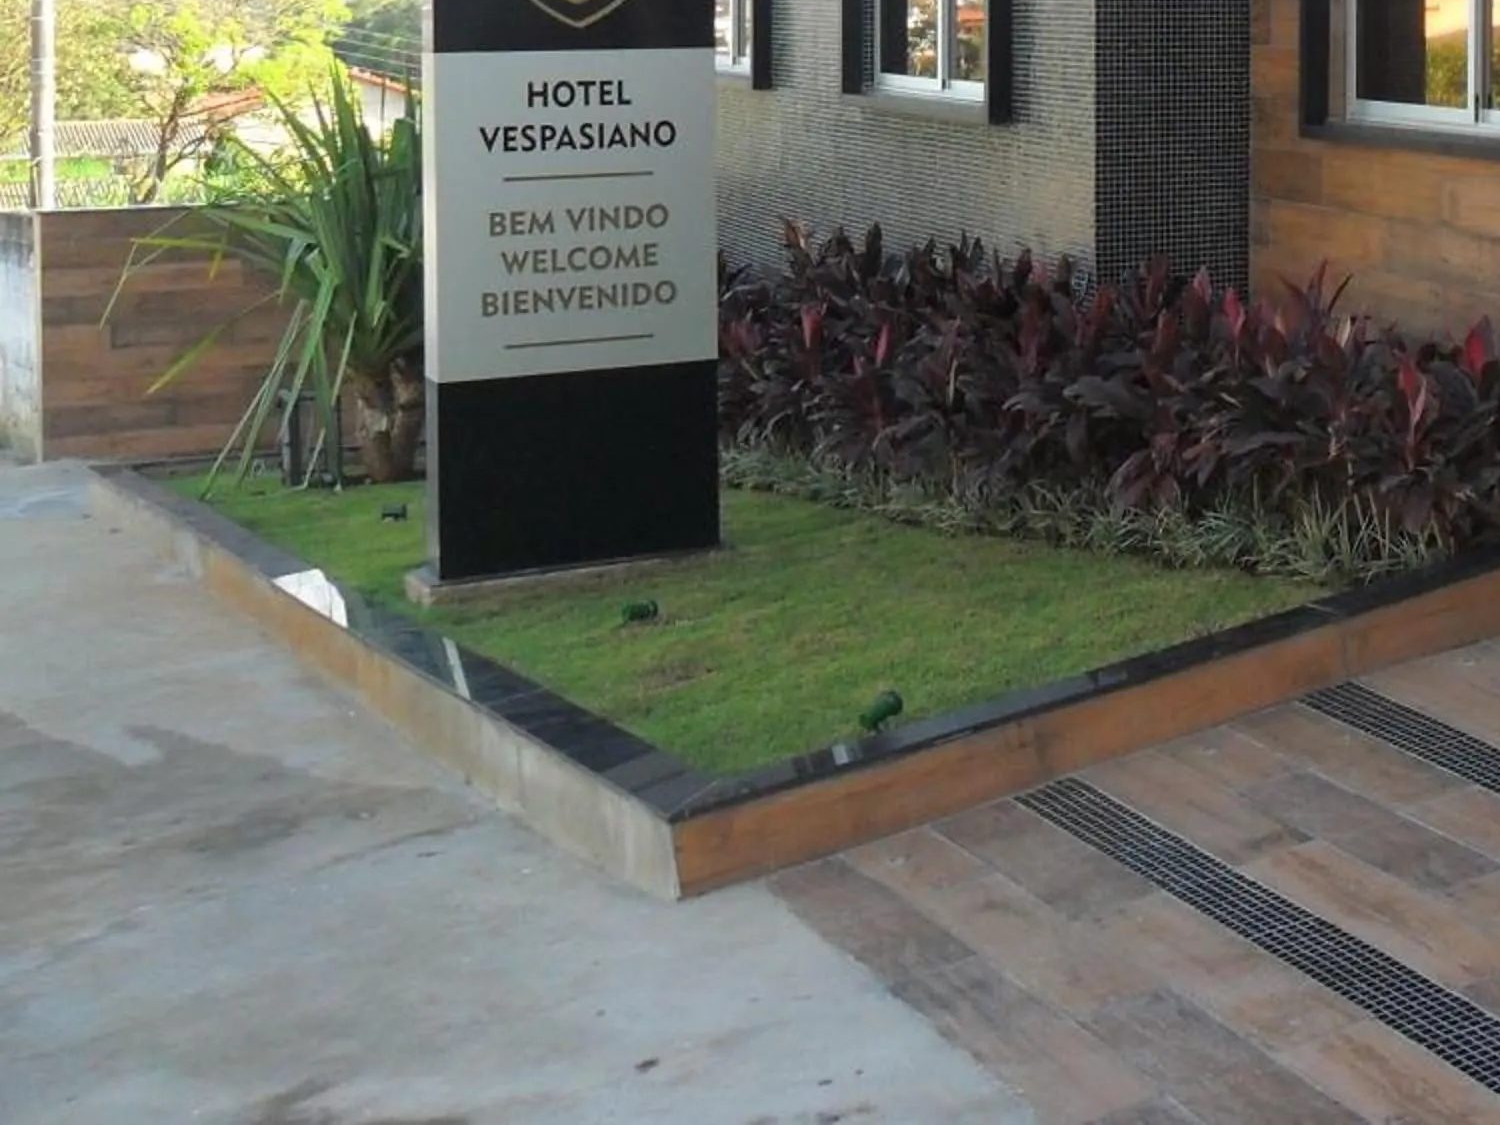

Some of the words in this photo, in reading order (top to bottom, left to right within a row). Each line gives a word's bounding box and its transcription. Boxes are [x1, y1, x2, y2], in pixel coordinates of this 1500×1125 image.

[527, 80, 632, 108] HOTEL
[479, 120, 677, 152] VESPASIANO
[489, 211, 555, 237] BEM
[565, 204, 669, 232] VINDO
[501, 243, 659, 275] WELCOME
[481, 280, 677, 317] BIENVENIDO
